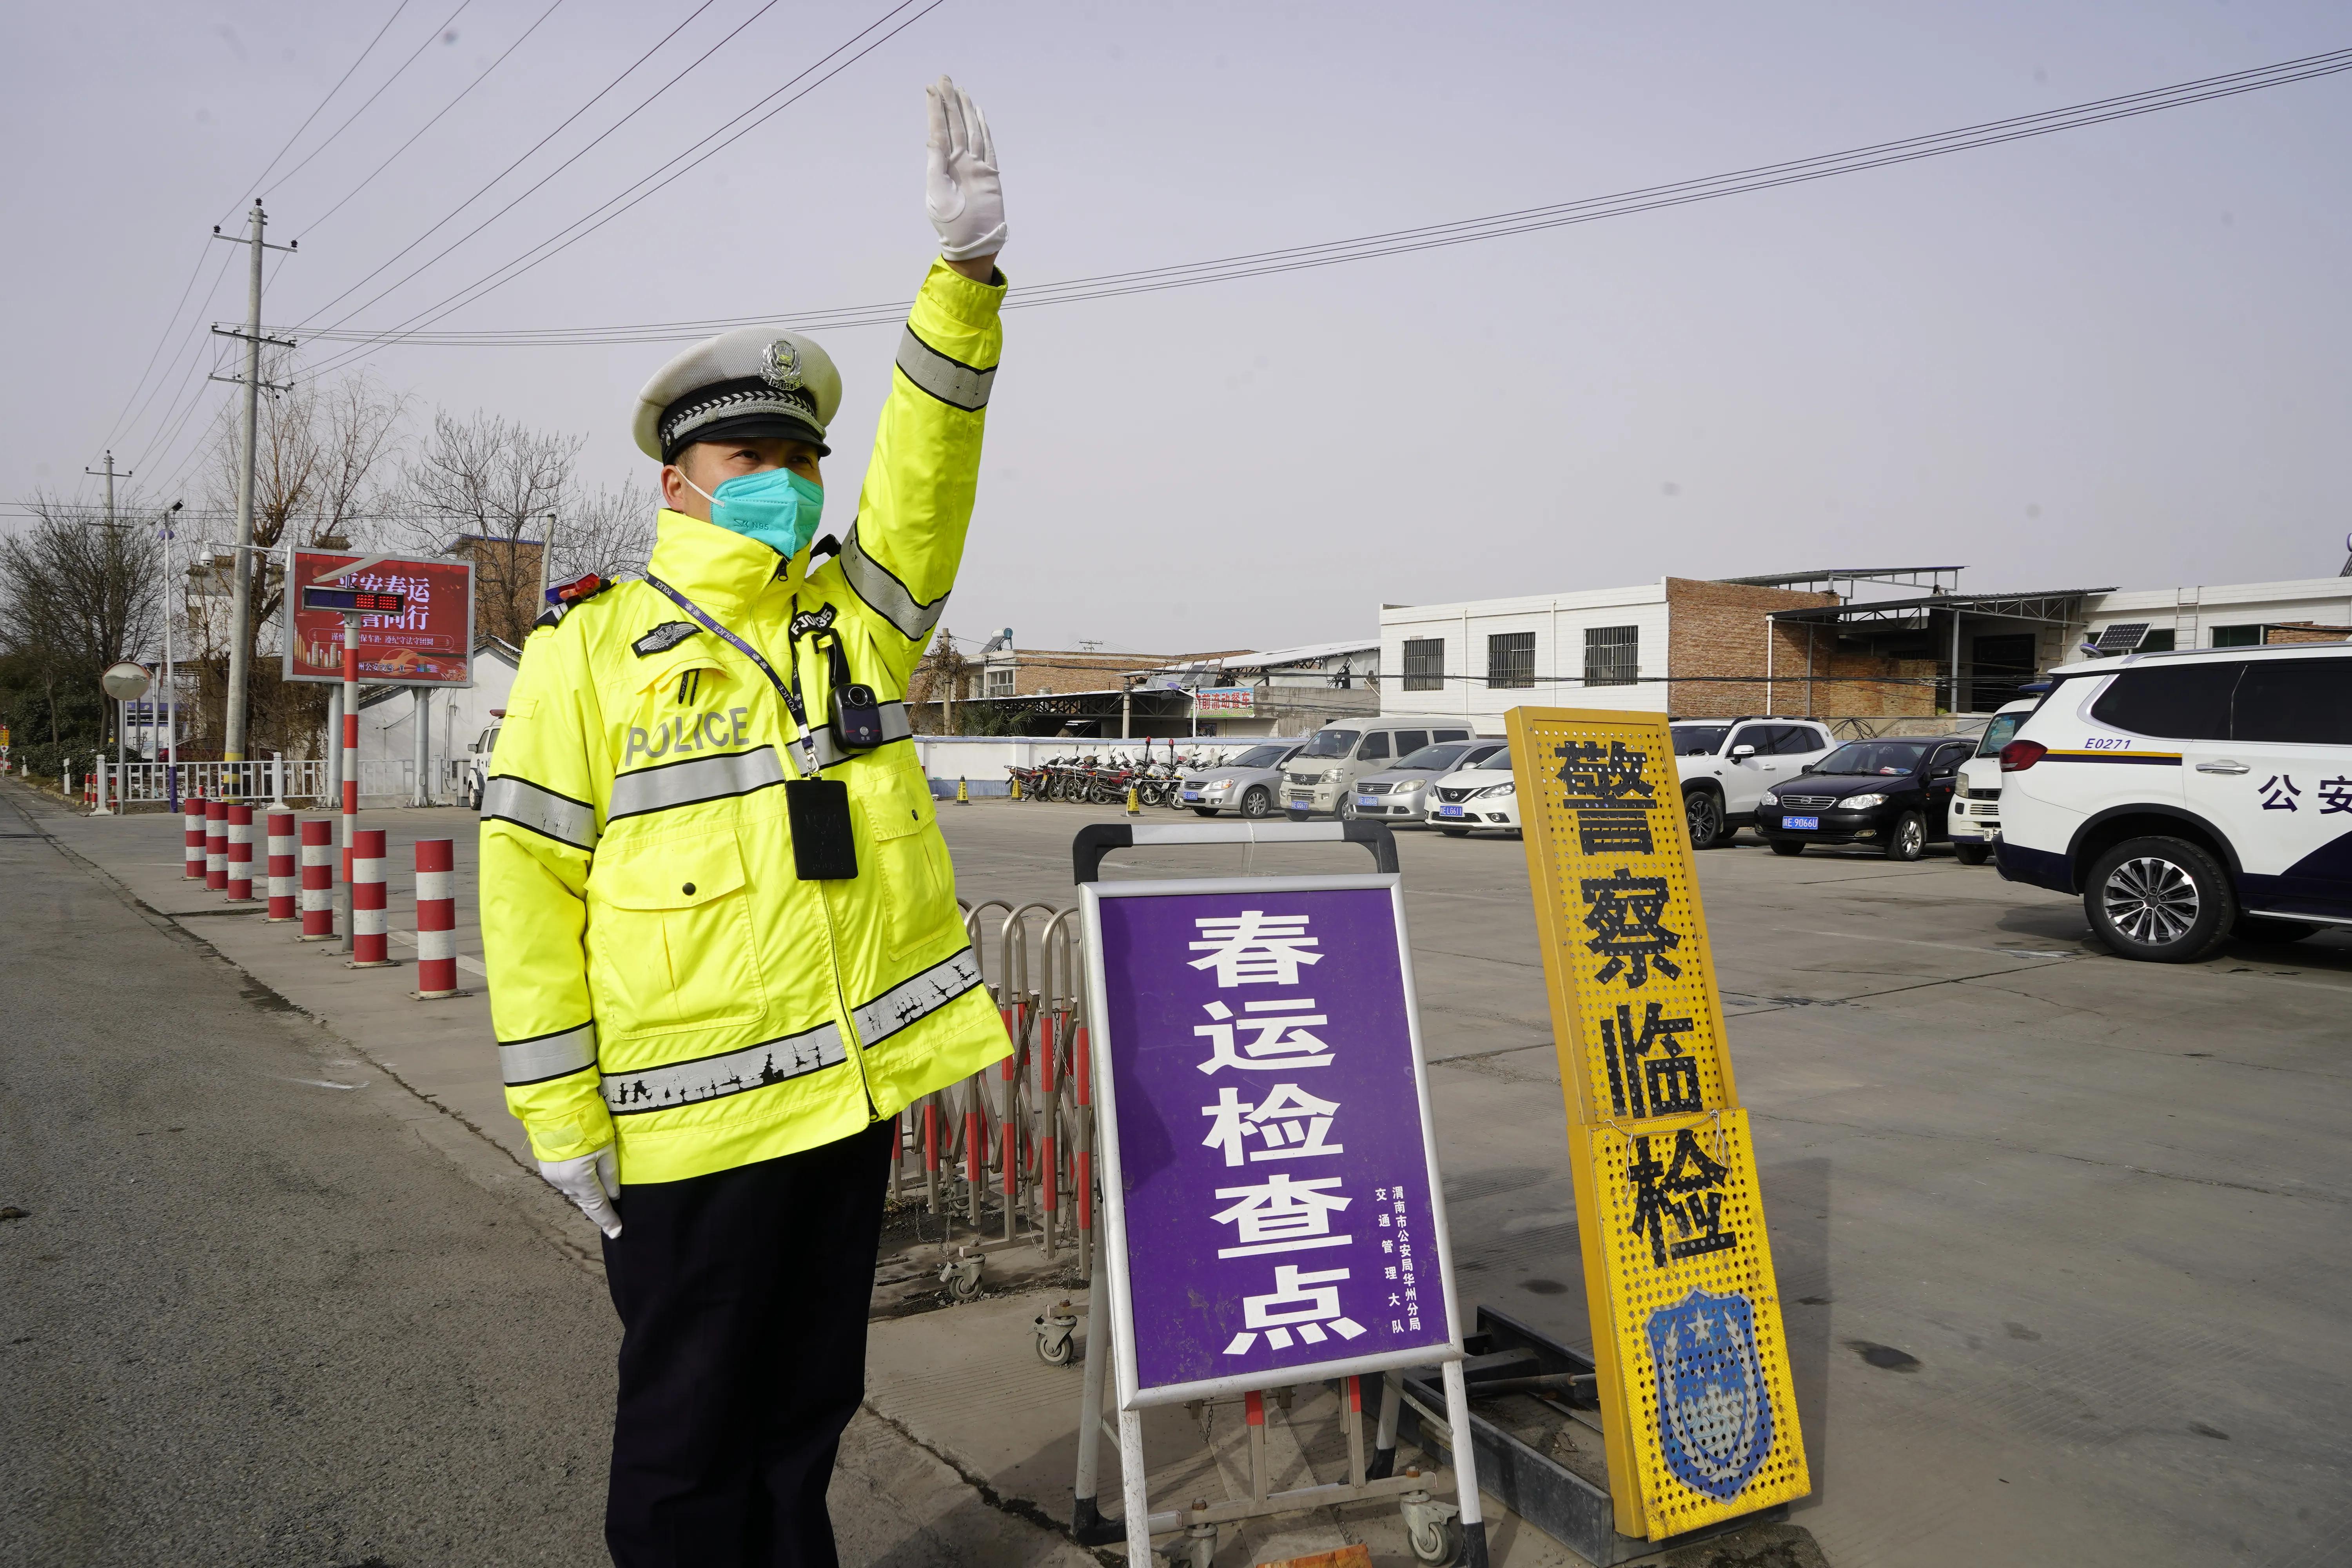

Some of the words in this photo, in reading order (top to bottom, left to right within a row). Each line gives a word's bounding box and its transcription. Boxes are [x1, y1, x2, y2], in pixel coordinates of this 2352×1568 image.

[772, 380, 792, 389] POLICE
[752, 522, 769, 530] N95
[655, 581, 673, 596] POLICE
[331, 632, 382, 643] 谨慎保车距
[713, 625, 737, 643] POLICE
[778, 684, 797, 712] POLICE
[625, 707, 750, 766] POLICE
[2085, 738, 2131, 749] E0271
[2258, 775, 2352, 814] 公安
[1554, 739, 1737, 1269] 警察临检
[1186, 909, 1367, 1355] 春运检查点
[1375, 1188, 1405, 1334] 交通管理大队
[1392, 1186, 1421, 1332] 渭南市公安局华州分局
